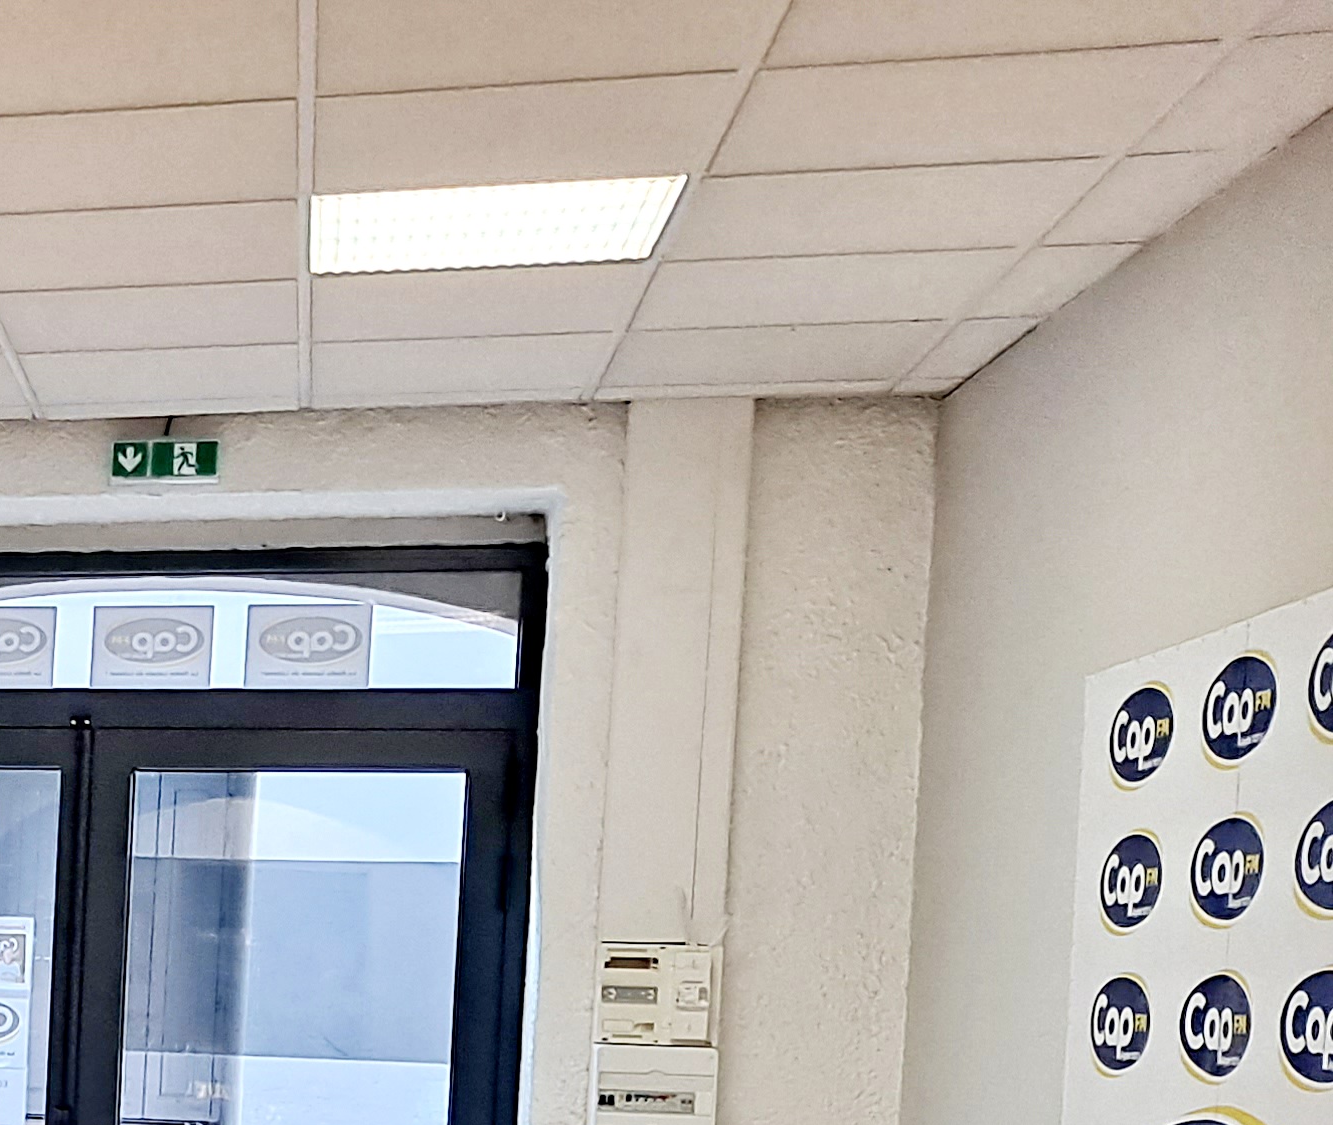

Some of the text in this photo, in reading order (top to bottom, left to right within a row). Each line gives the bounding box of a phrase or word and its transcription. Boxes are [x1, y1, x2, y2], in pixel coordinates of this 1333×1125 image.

[1113, 710, 1156, 771] Cap
[1206, 680, 1254, 746] Cap
[1103, 853, 1145, 917] Cap
[1195, 838, 1244, 908] Cap
[1093, 993, 1133, 1060] Cap
[1185, 992, 1232, 1065] Cap
